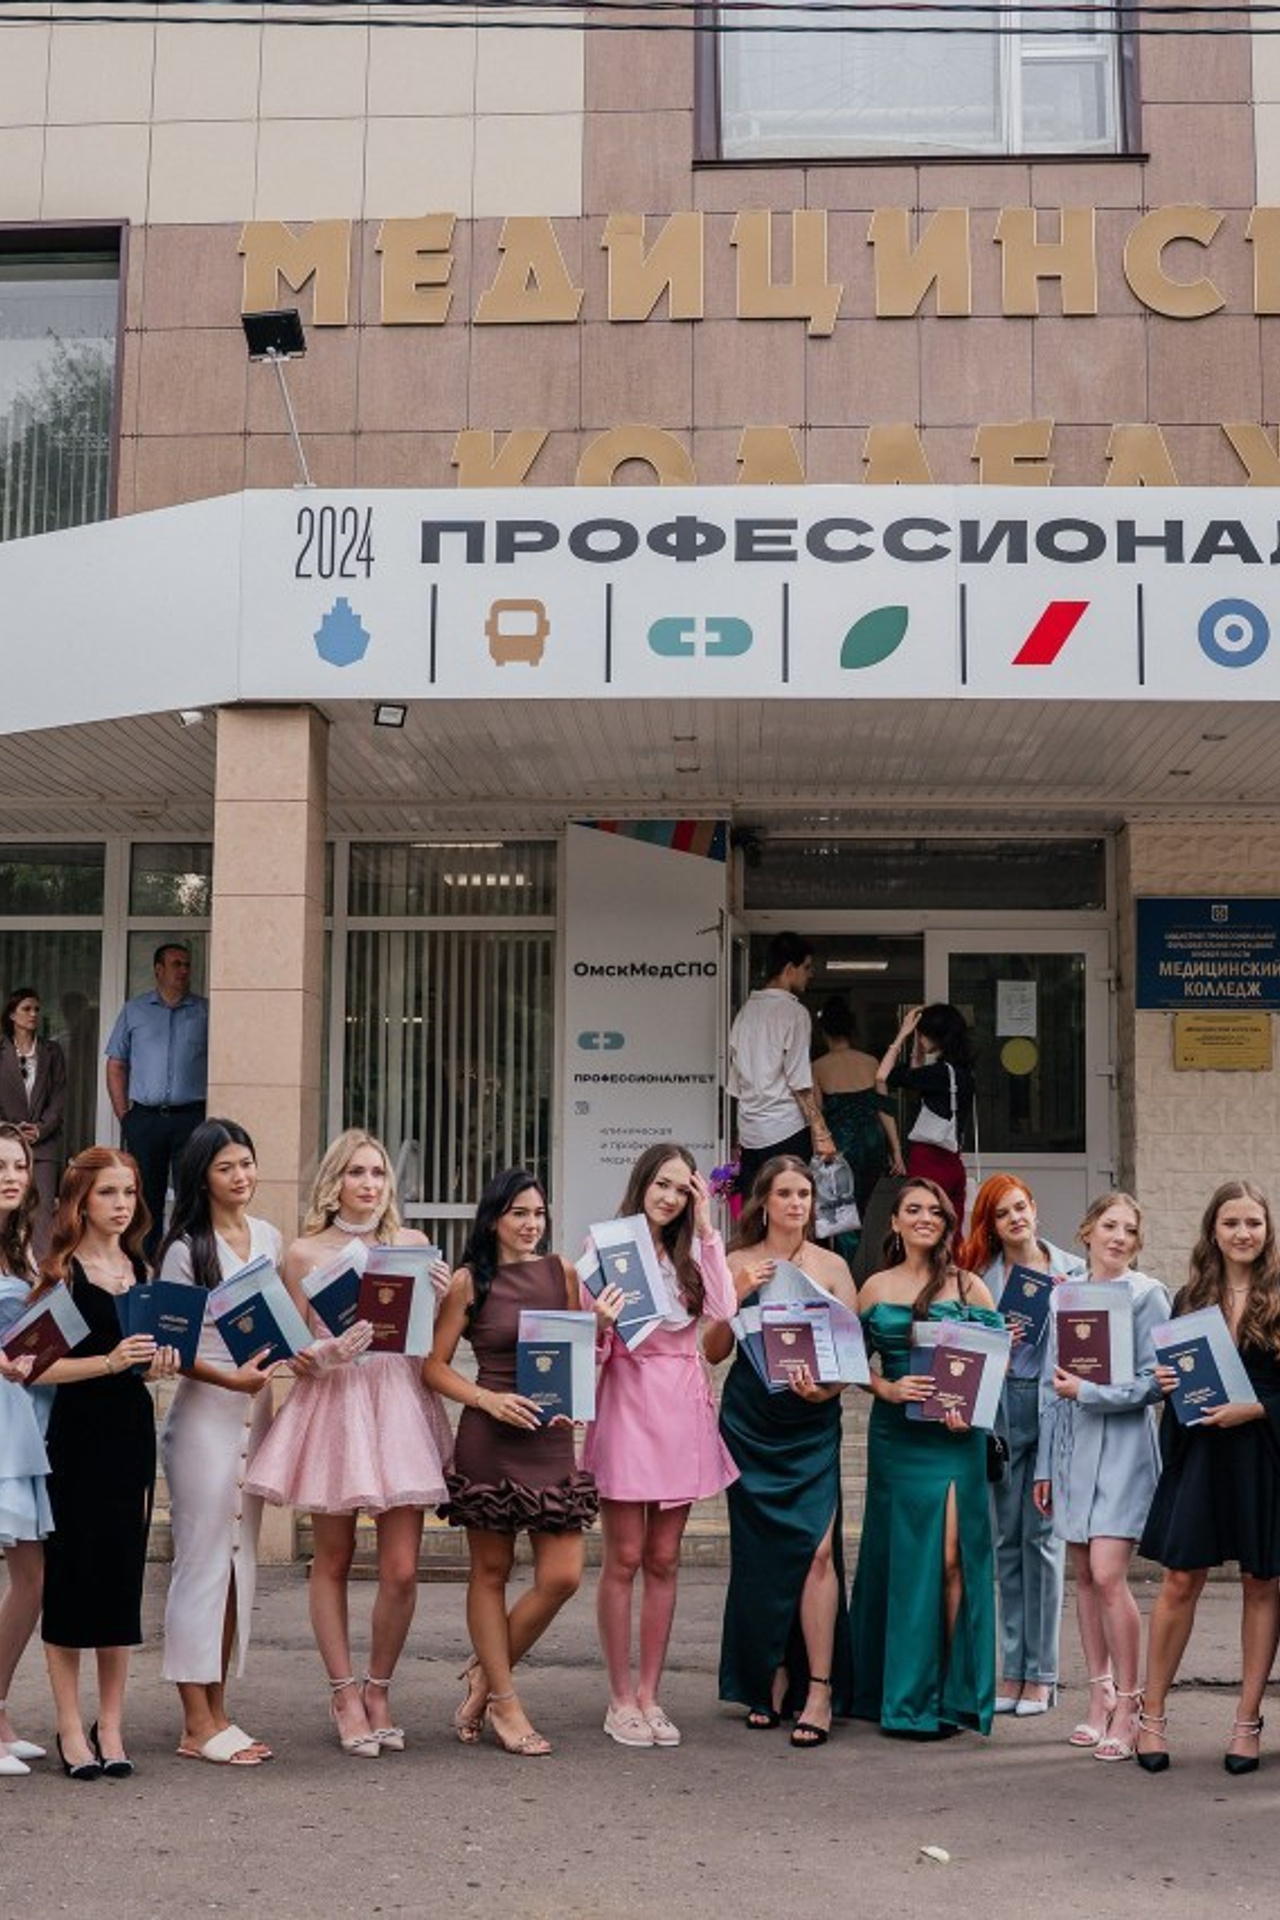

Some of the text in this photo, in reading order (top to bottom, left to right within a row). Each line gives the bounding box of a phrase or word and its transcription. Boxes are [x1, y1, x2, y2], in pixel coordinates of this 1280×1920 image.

[295, 506, 375, 579] 2024
[420, 515, 1280, 564] ПРОФЕССИОНА
[573, 961, 717, 979] ОмскМедСПО
[1184, 981, 1262, 998] КОЛЛЕДЖ
[574, 1073, 716, 1084] ПРОФЕССИОНАЛИТЕТ
